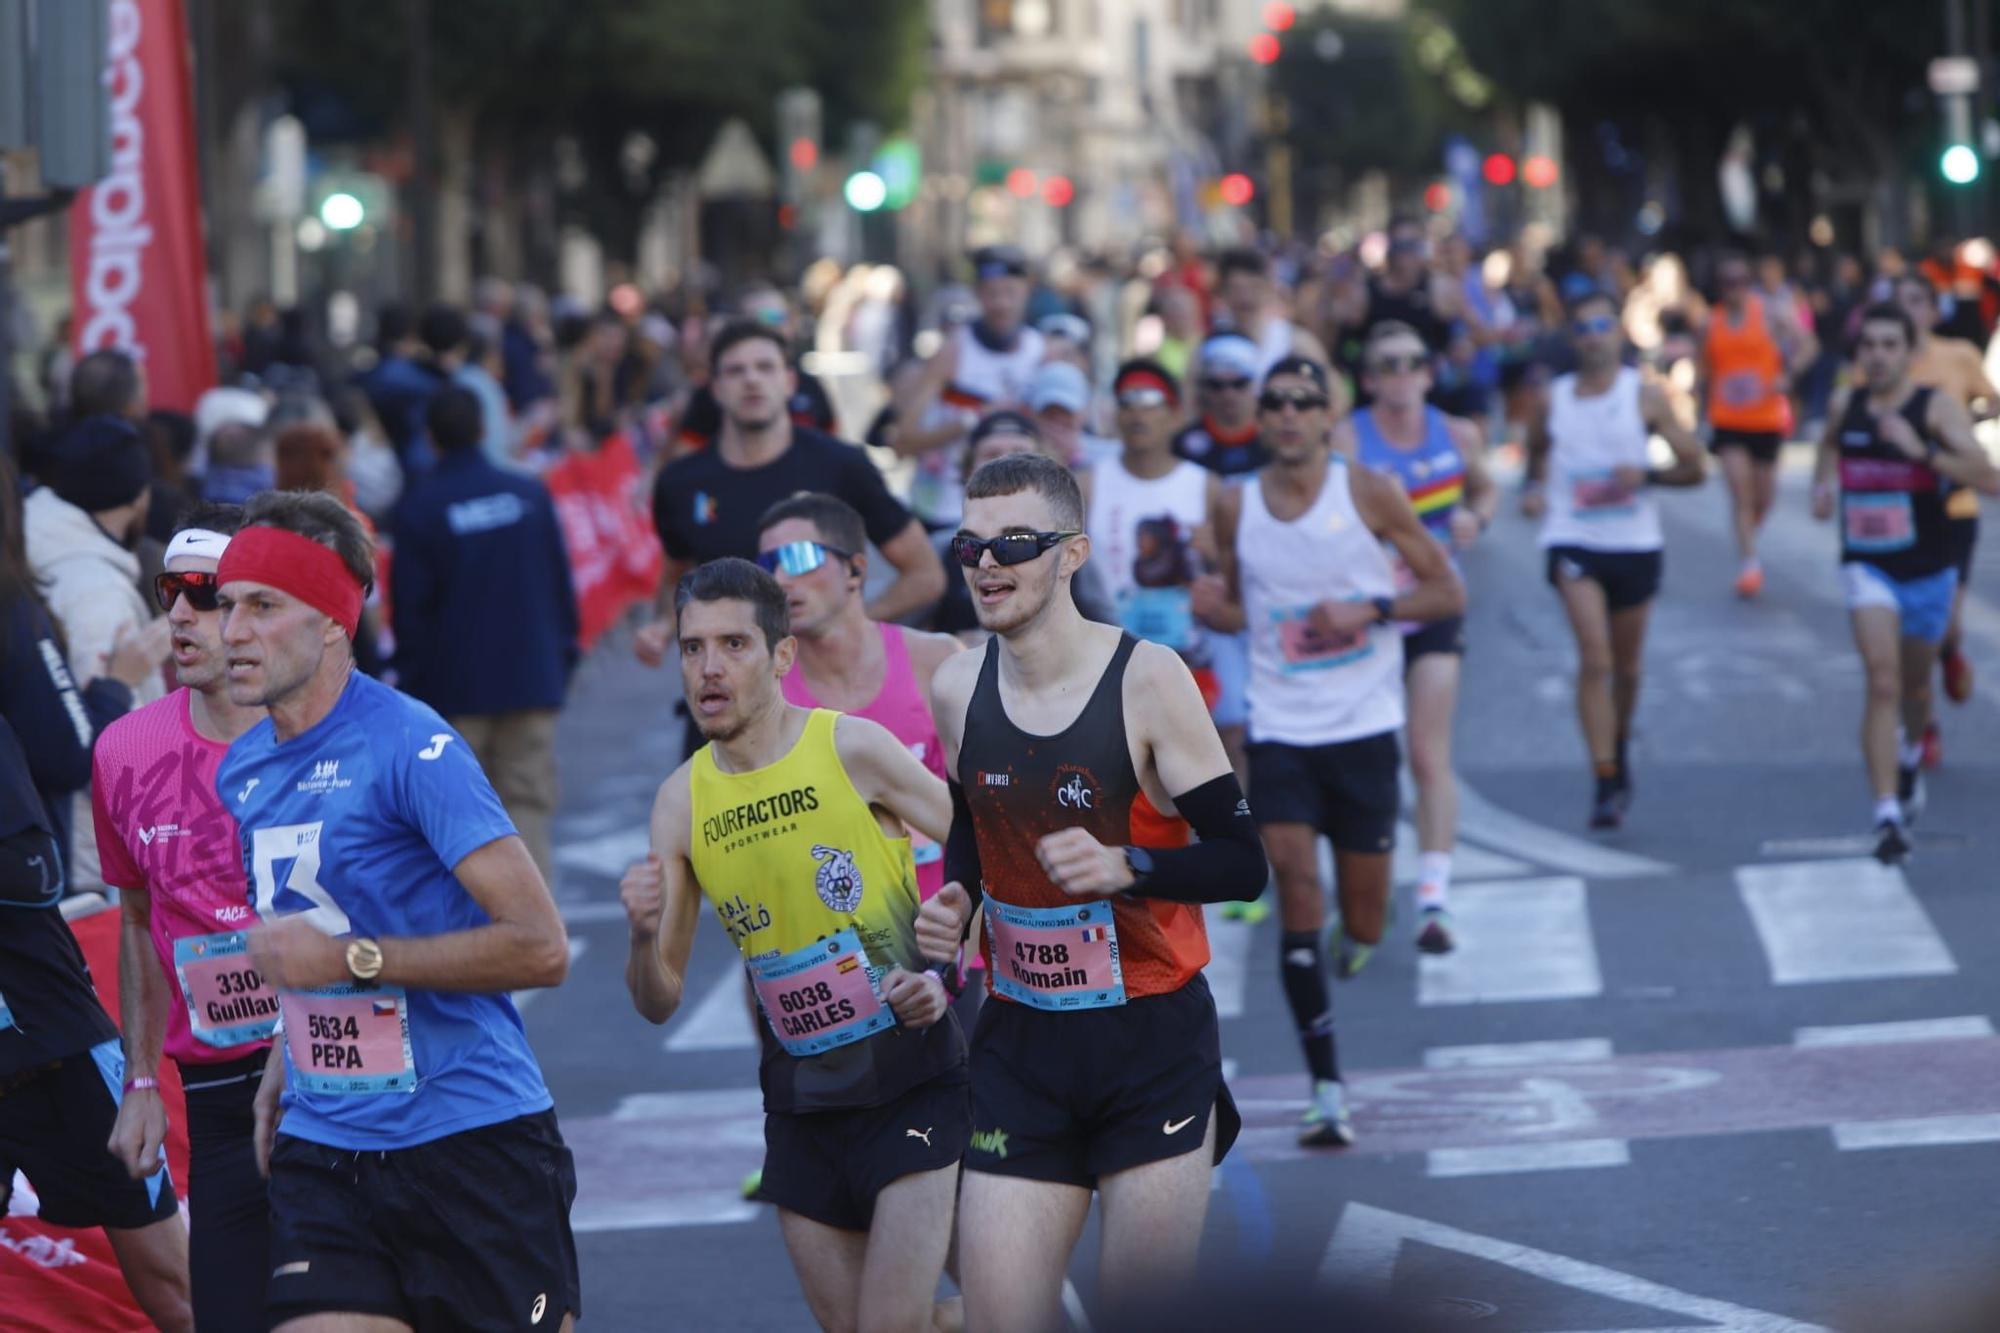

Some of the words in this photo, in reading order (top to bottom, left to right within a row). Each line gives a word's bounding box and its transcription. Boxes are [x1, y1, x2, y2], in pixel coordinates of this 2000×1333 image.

[703, 786, 819, 848] FOURFACTORS
[724, 822, 798, 854] SPORTWEAR
[1015, 941, 1069, 965] 4788
[216, 969, 266, 996] 330
[1011, 958, 1087, 988] Romain
[778, 981, 832, 1013] 6038
[309, 1014, 359, 1040] 5634
[782, 999, 856, 1036] CARLES
[311, 1043, 363, 1069] PEPA
